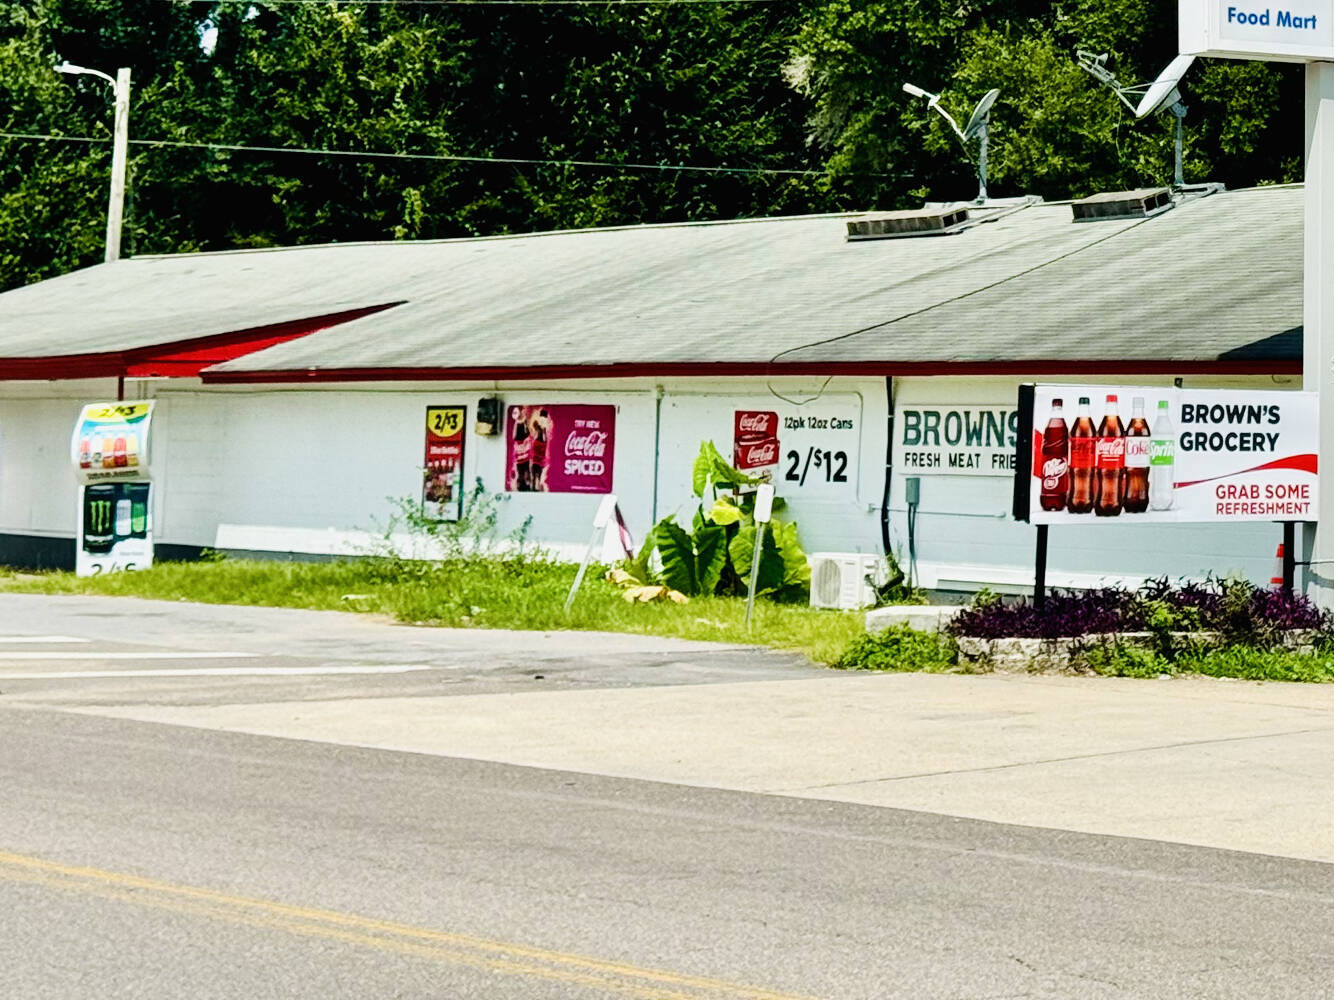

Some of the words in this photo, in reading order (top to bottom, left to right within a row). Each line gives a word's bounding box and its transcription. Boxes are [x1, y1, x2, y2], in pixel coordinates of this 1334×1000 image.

[1228, 7, 1270, 26] Food
[1276, 10, 1317, 30] Mart
[1181, 403, 1281, 425] BROWN'S
[784, 416, 805, 431] 12pk
[808, 416, 828, 429] 12oz
[830, 417, 854, 430] Cans
[1180, 431, 1280, 452] GROCERY
[563, 459, 605, 476] SPICED
[785, 446, 848, 487] 2/$12
[904, 452, 941, 468] FRESH
[948, 452, 982, 468] MEAT
[991, 453, 1017, 470] FRIE
[1216, 484, 1260, 500] GRAB
[1265, 484, 1310, 500] SOME
[1216, 502, 1311, 515] REFRESHMENT
